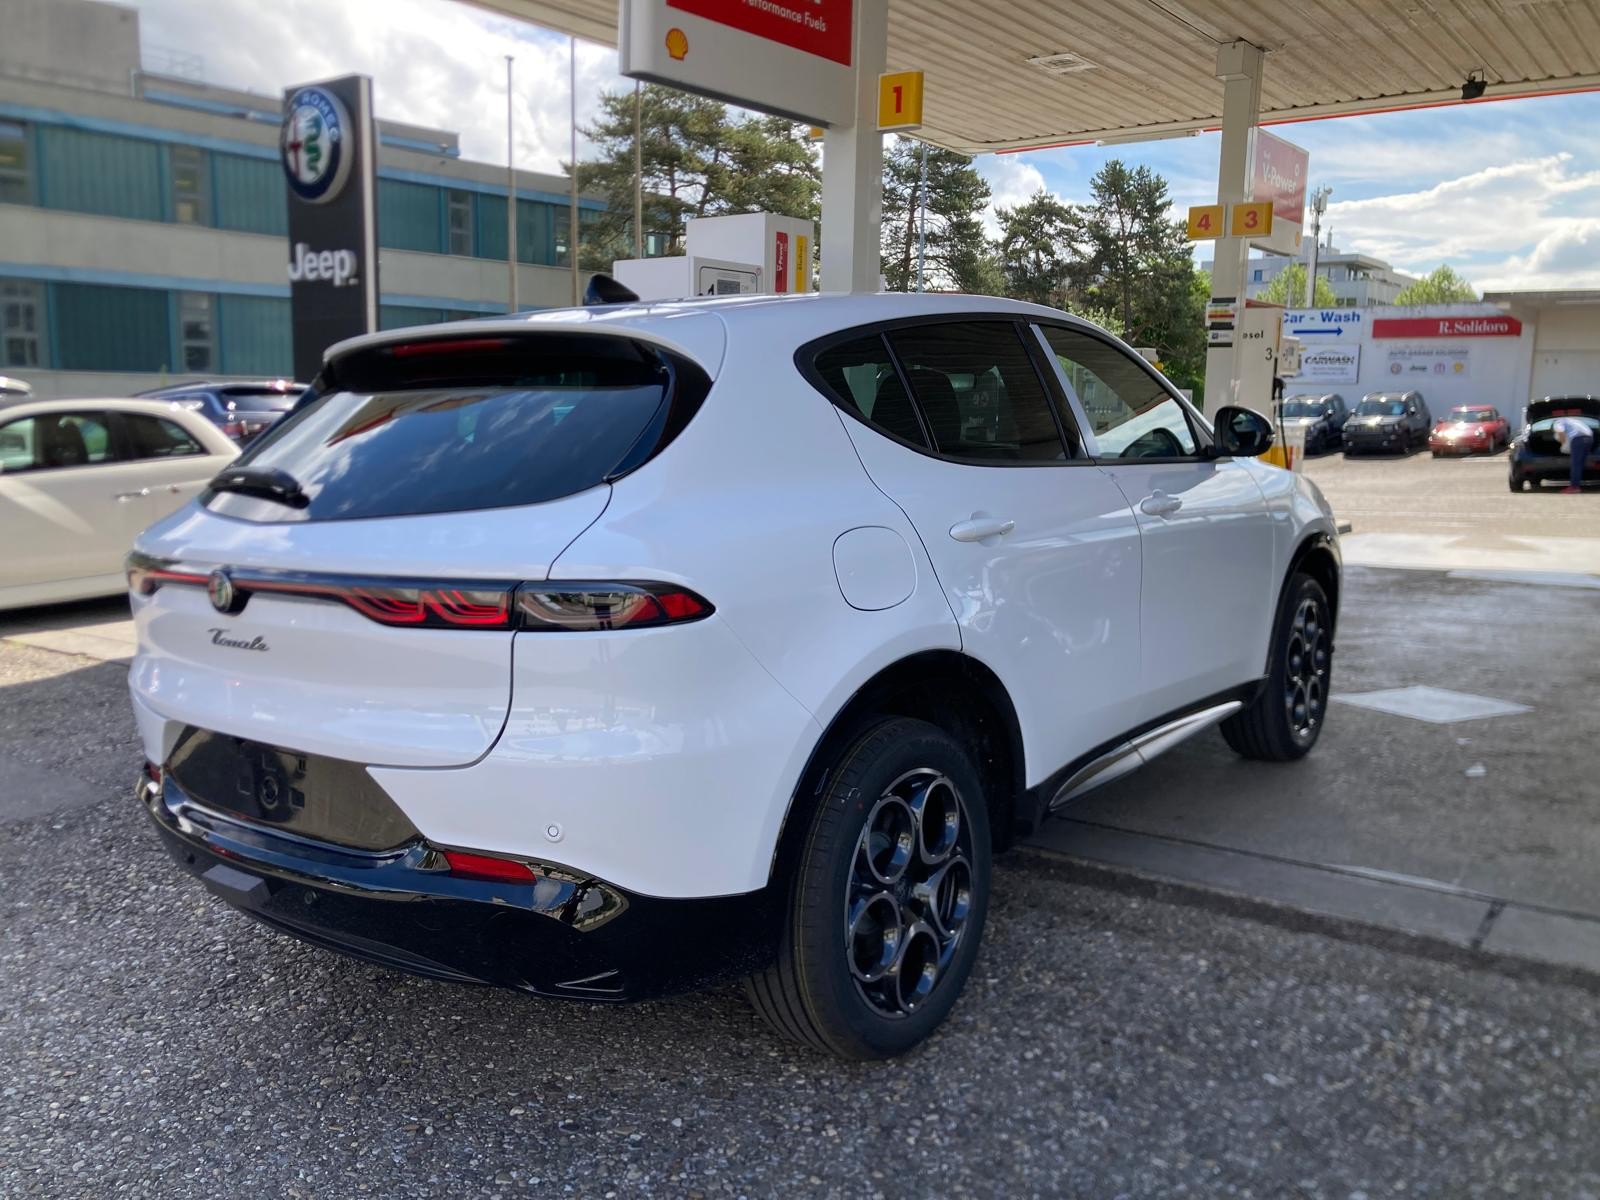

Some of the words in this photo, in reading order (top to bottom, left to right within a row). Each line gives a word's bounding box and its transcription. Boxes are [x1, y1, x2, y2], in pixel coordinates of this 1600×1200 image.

[742, 0, 802, 22] erformance
[804, 11, 827, 32] Fuels
[892, 85, 903, 114] 1
[1196, 213, 1211, 231] 4
[1244, 209, 1258, 229] 3
[287, 241, 355, 287] Jeep
[1321, 311, 1360, 323] Wash
[1265, 347, 1273, 361] 3
[207, 628, 270, 651] Tonale
